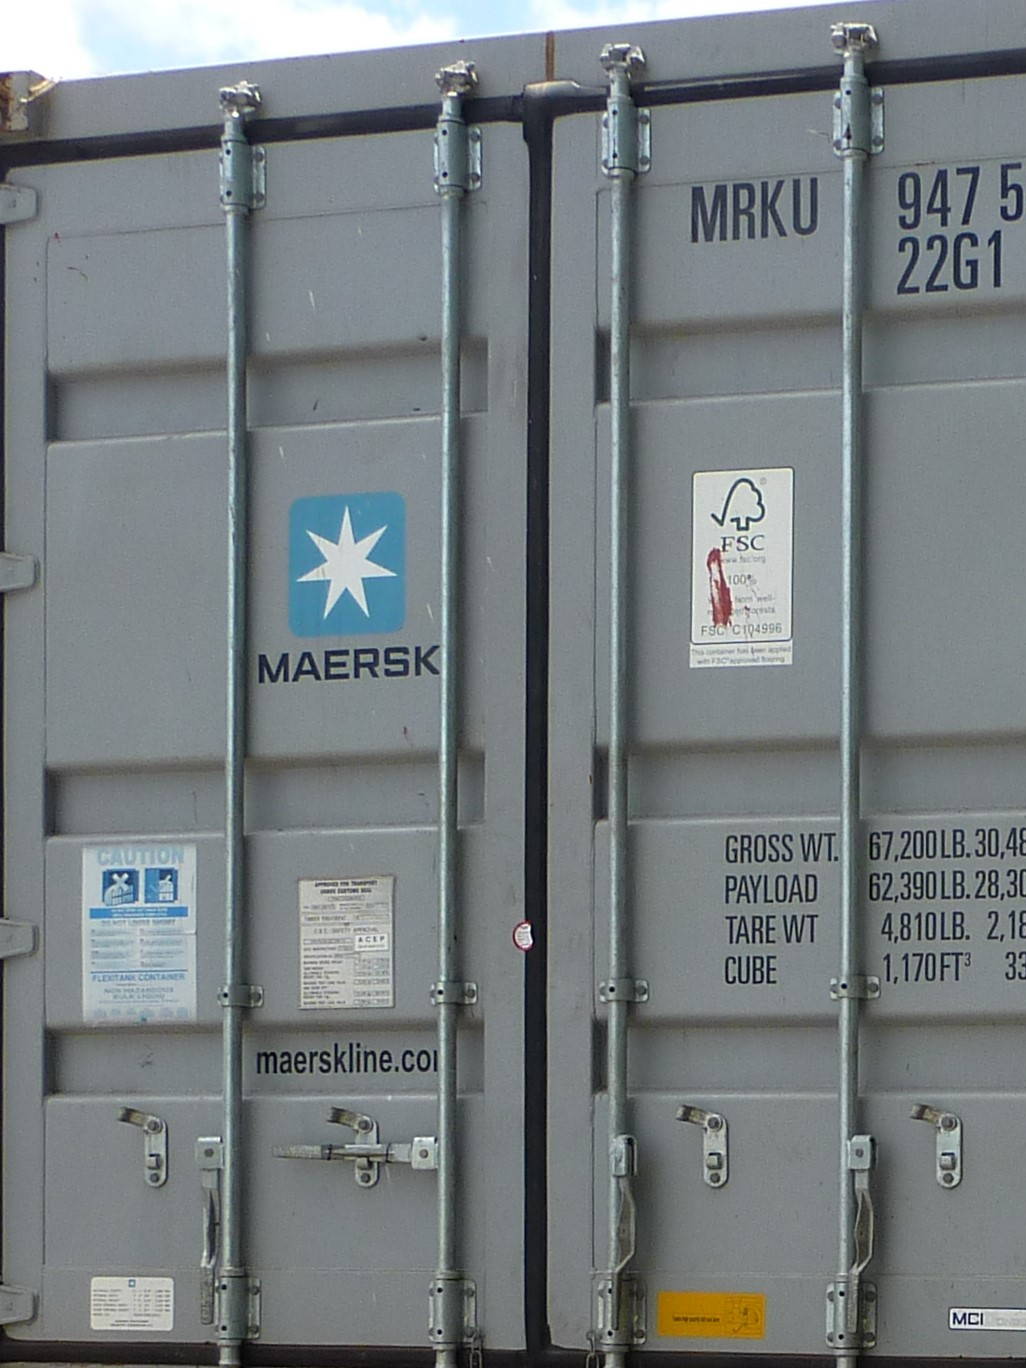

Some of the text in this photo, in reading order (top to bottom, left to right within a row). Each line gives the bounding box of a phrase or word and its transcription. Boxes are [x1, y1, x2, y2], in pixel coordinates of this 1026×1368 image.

[691, 177, 818, 243] MRKU
[898, 166, 980, 229] 947
[897, 230, 1002, 295] 22G1
[720, 535, 765, 552] FSC
[258, 645, 441, 685] MAERSK
[98, 846, 185, 866] CAUTION
[725, 833, 794, 864] GROSS
[800, 831, 839, 863] WT.
[869, 830, 937, 862] 67,200
[941, 828, 971, 859] LB.
[725, 873, 818, 905] PAYLOAD
[869, 871, 937, 903] 62,390
[941, 869, 971, 901] LB.
[725, 915, 777, 945] TARE
[783, 914, 819, 944] WT
[881, 911, 937, 944] 4,810
[941, 910, 971, 941] LB.
[725, 955, 777, 985] CUBE
[884, 952, 937, 985] 1,170
[952, 1312, 984, 1326] MCI
